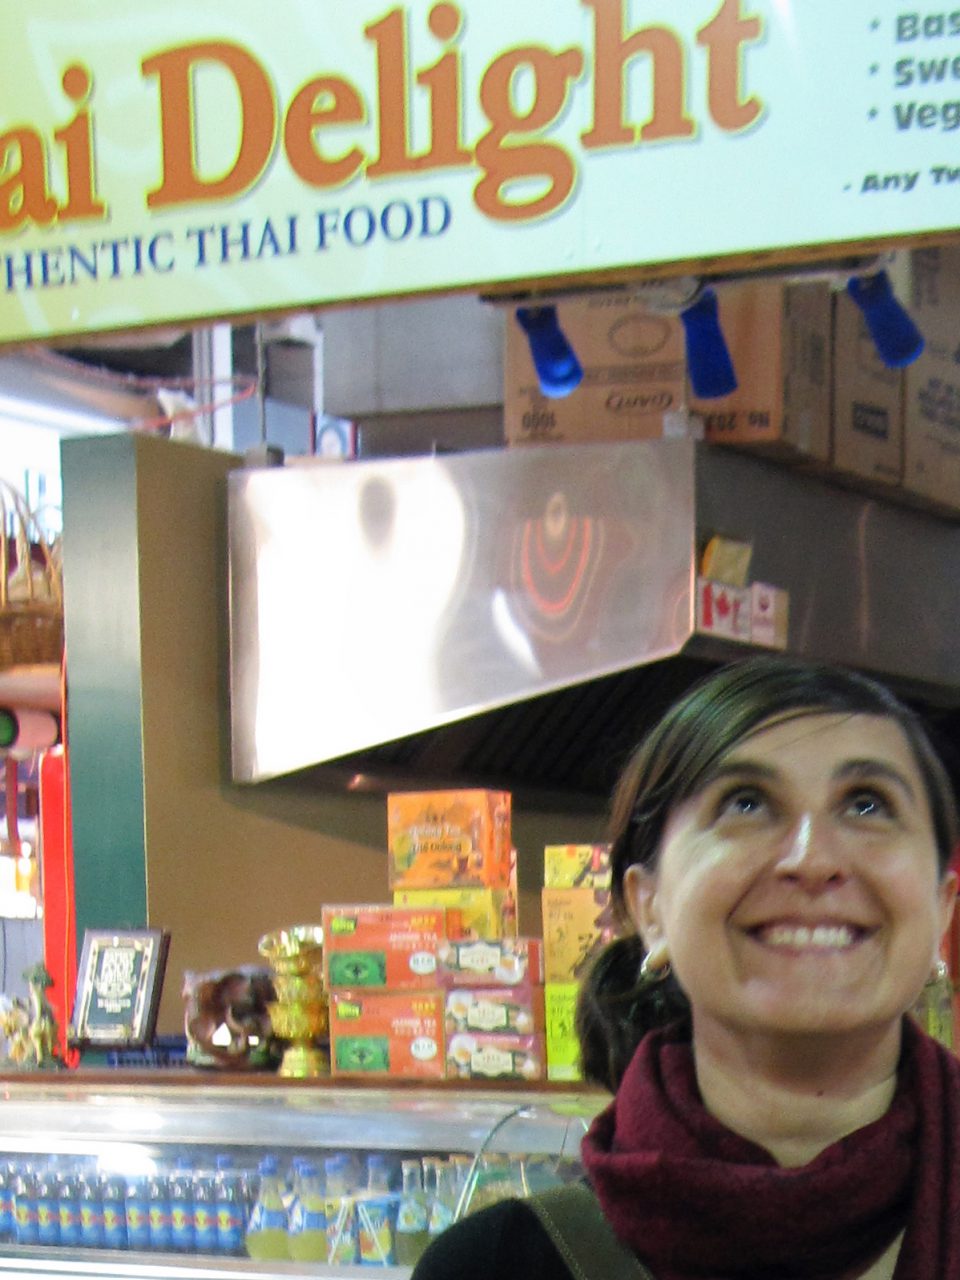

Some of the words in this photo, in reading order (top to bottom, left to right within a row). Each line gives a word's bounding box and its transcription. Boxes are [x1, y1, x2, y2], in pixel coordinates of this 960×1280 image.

[142, 0, 763, 222] Delight
[861, 169, 919, 195] Any
[187, 213, 302, 269] THAI
[313, 195, 453, 255] FOOD
